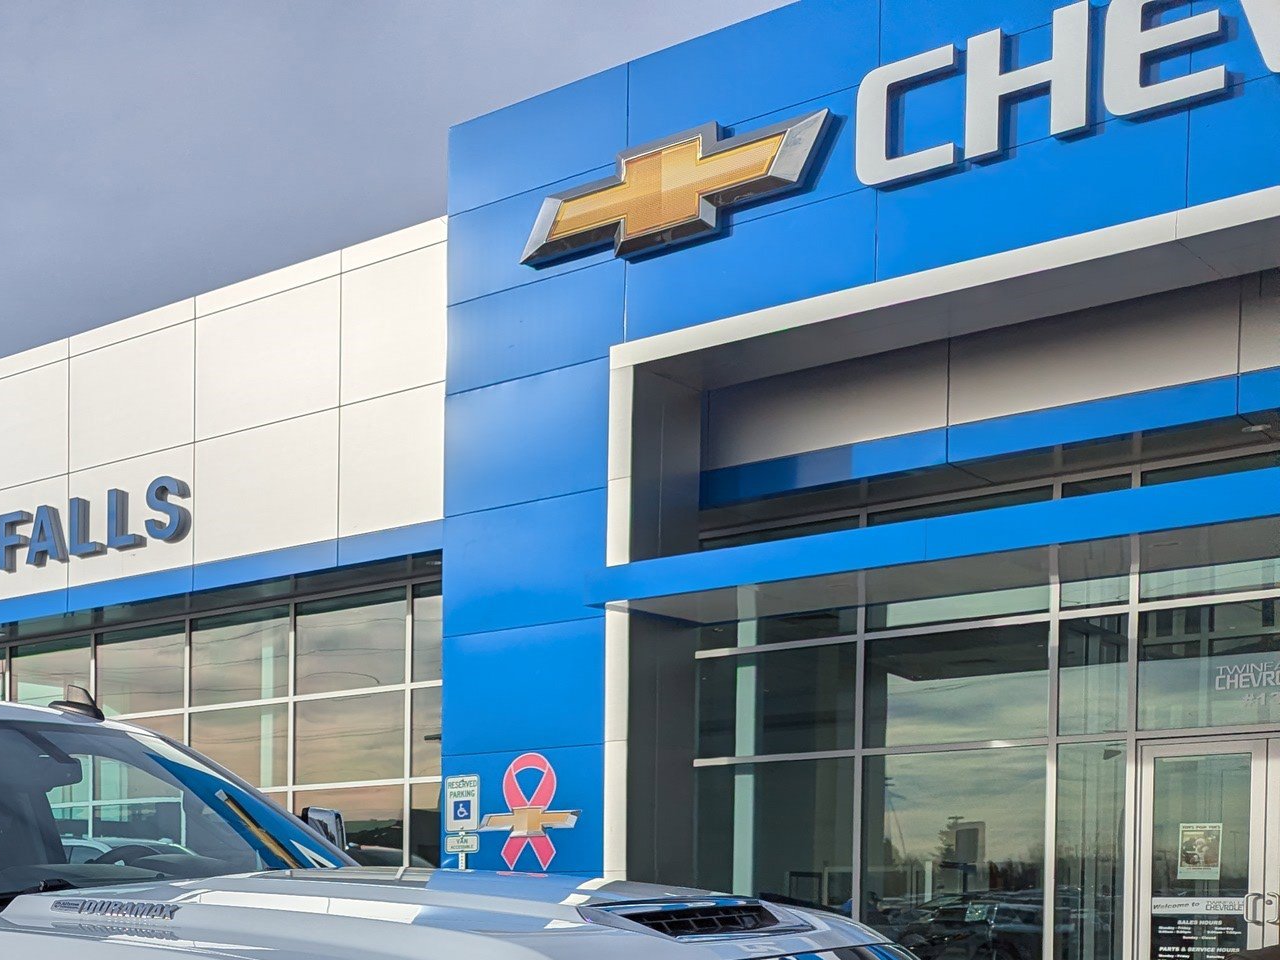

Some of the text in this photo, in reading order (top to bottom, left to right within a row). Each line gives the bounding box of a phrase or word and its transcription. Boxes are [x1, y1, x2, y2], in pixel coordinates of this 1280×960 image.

[447, 780, 478, 789] RESERVED
[449, 790, 475, 798] PARKING
[81, 900, 182, 920] DURAMAX
